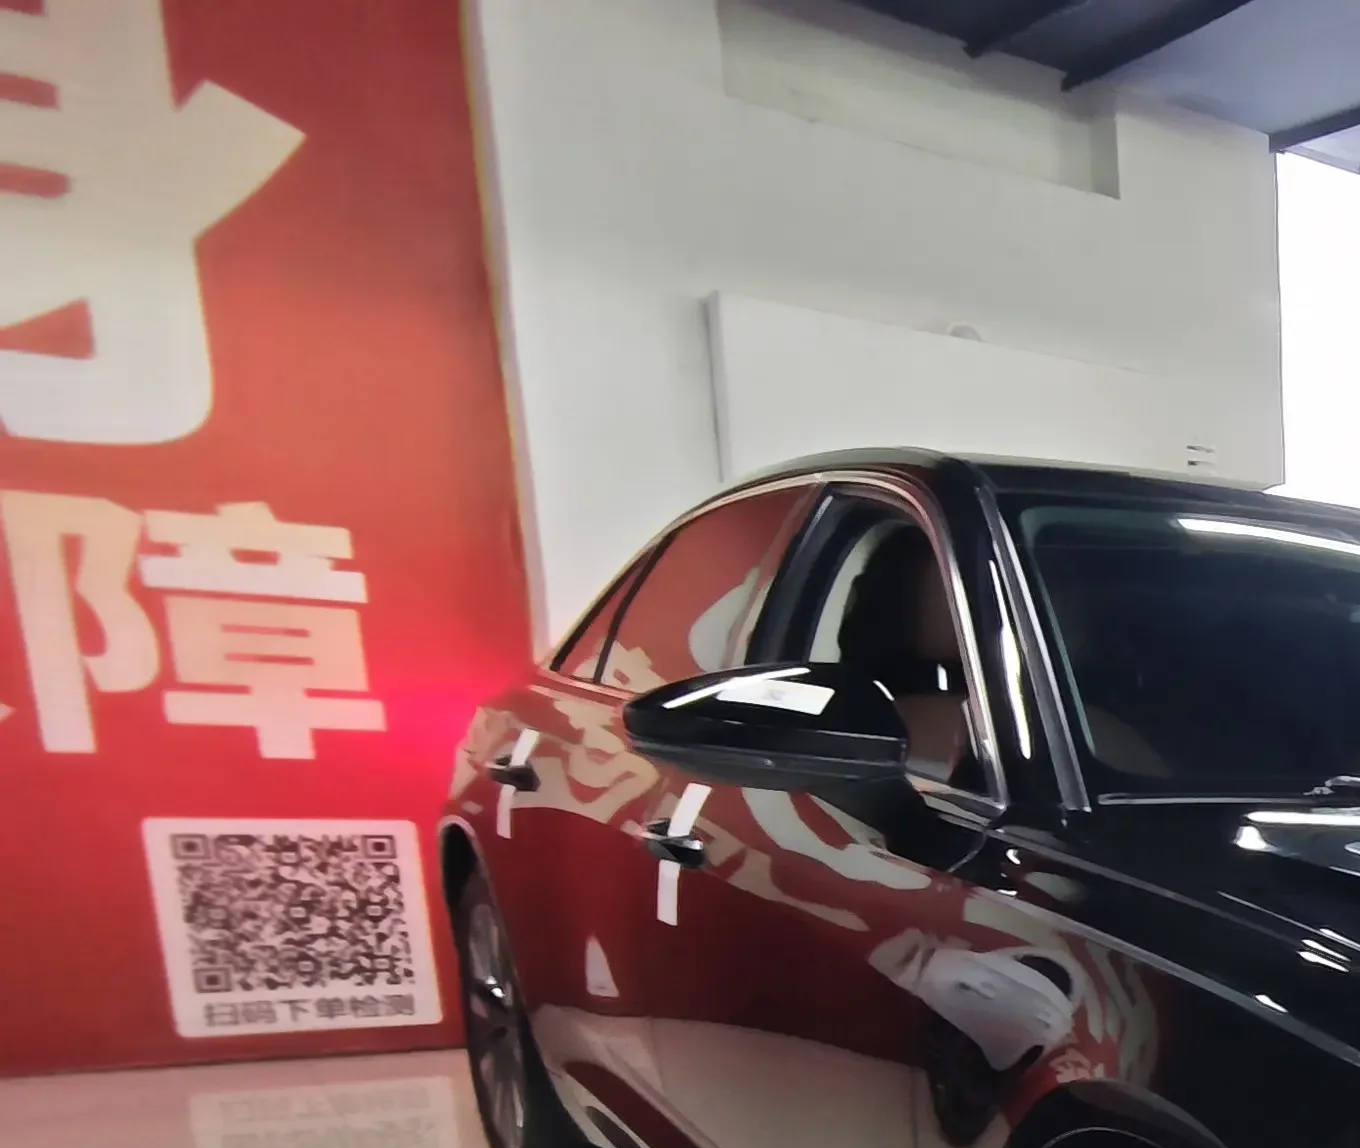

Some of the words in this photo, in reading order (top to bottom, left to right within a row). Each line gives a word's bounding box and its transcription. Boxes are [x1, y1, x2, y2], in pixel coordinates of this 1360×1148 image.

[0, 489, 386, 760] 障
[204, 994, 416, 1027] 扫码下单检测
